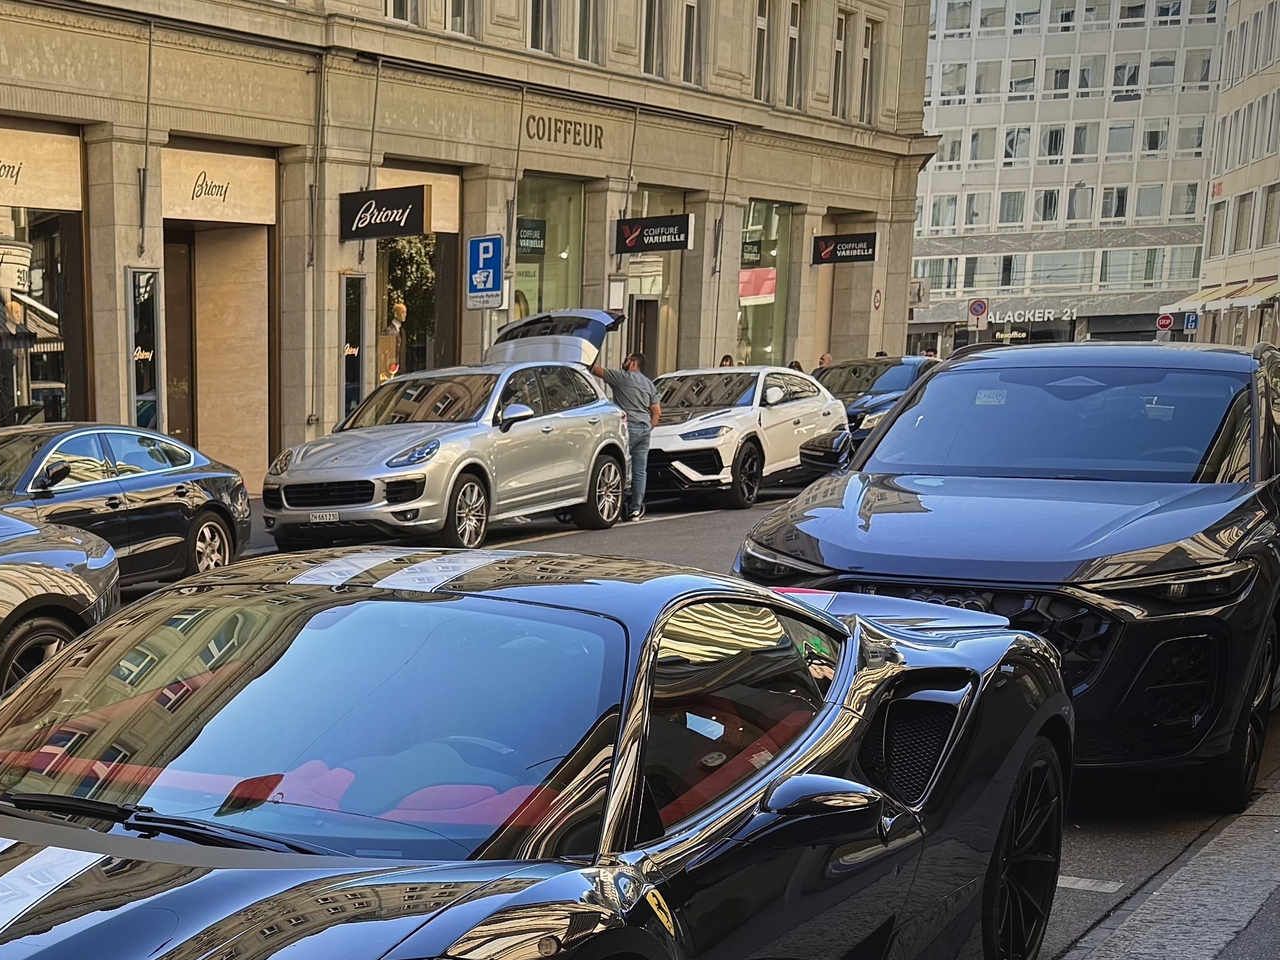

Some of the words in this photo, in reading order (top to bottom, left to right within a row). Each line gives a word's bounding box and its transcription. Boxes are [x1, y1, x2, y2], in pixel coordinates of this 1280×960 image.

[526, 114, 604, 149] COIFFEUR
[643, 226, 679, 236] COIFFURE
[643, 233, 686, 244] VARIBELLE
[837, 242, 867, 251] COIFFURE
[479, 242, 493, 268] P
[837, 248, 873, 257] VARIBELLE
[987, 309, 1054, 323] ALACKER
[1062, 308, 1078, 320] 21
